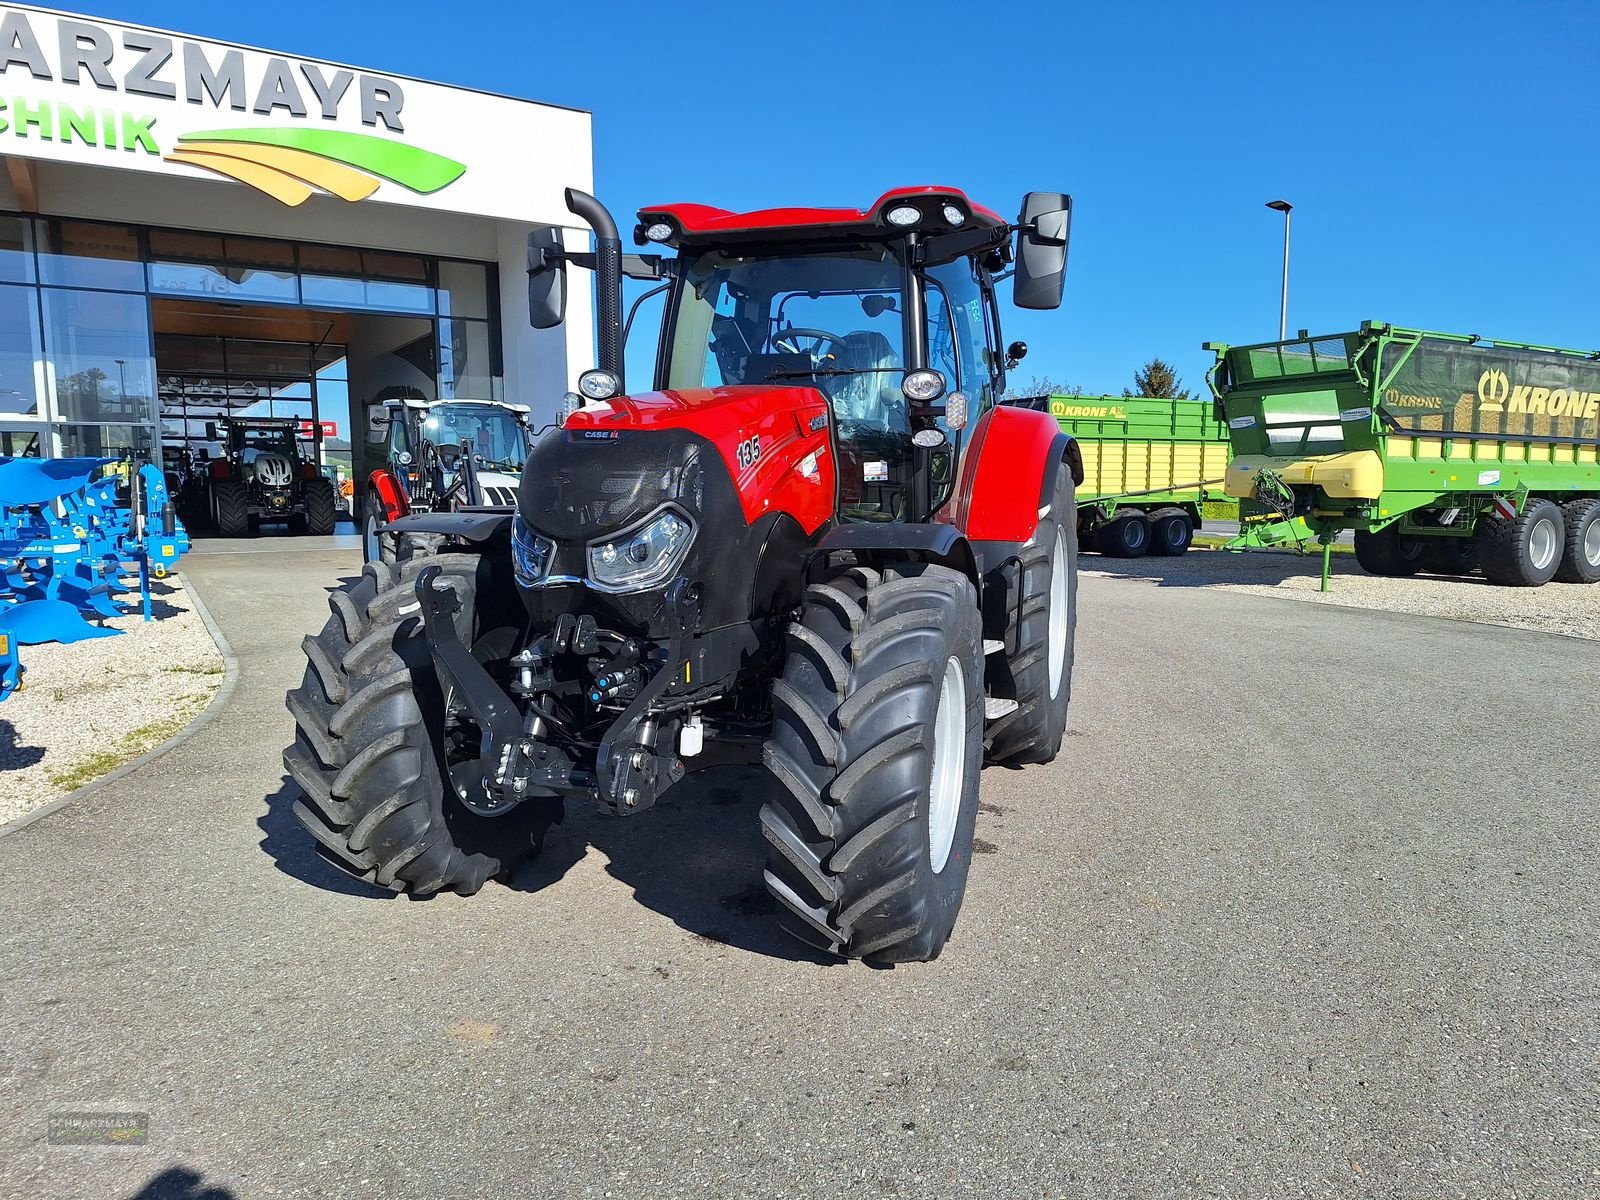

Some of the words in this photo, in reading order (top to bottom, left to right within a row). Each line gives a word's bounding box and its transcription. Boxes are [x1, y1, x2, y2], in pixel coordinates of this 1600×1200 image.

[0, 96, 160, 156] HNIK
[1064, 406, 1108, 417] KRONE
[1400, 394, 1442, 409] KRONE
[1507, 385, 1600, 419] KRONE
[584, 431, 609, 439] CASE
[737, 434, 762, 471] 135
